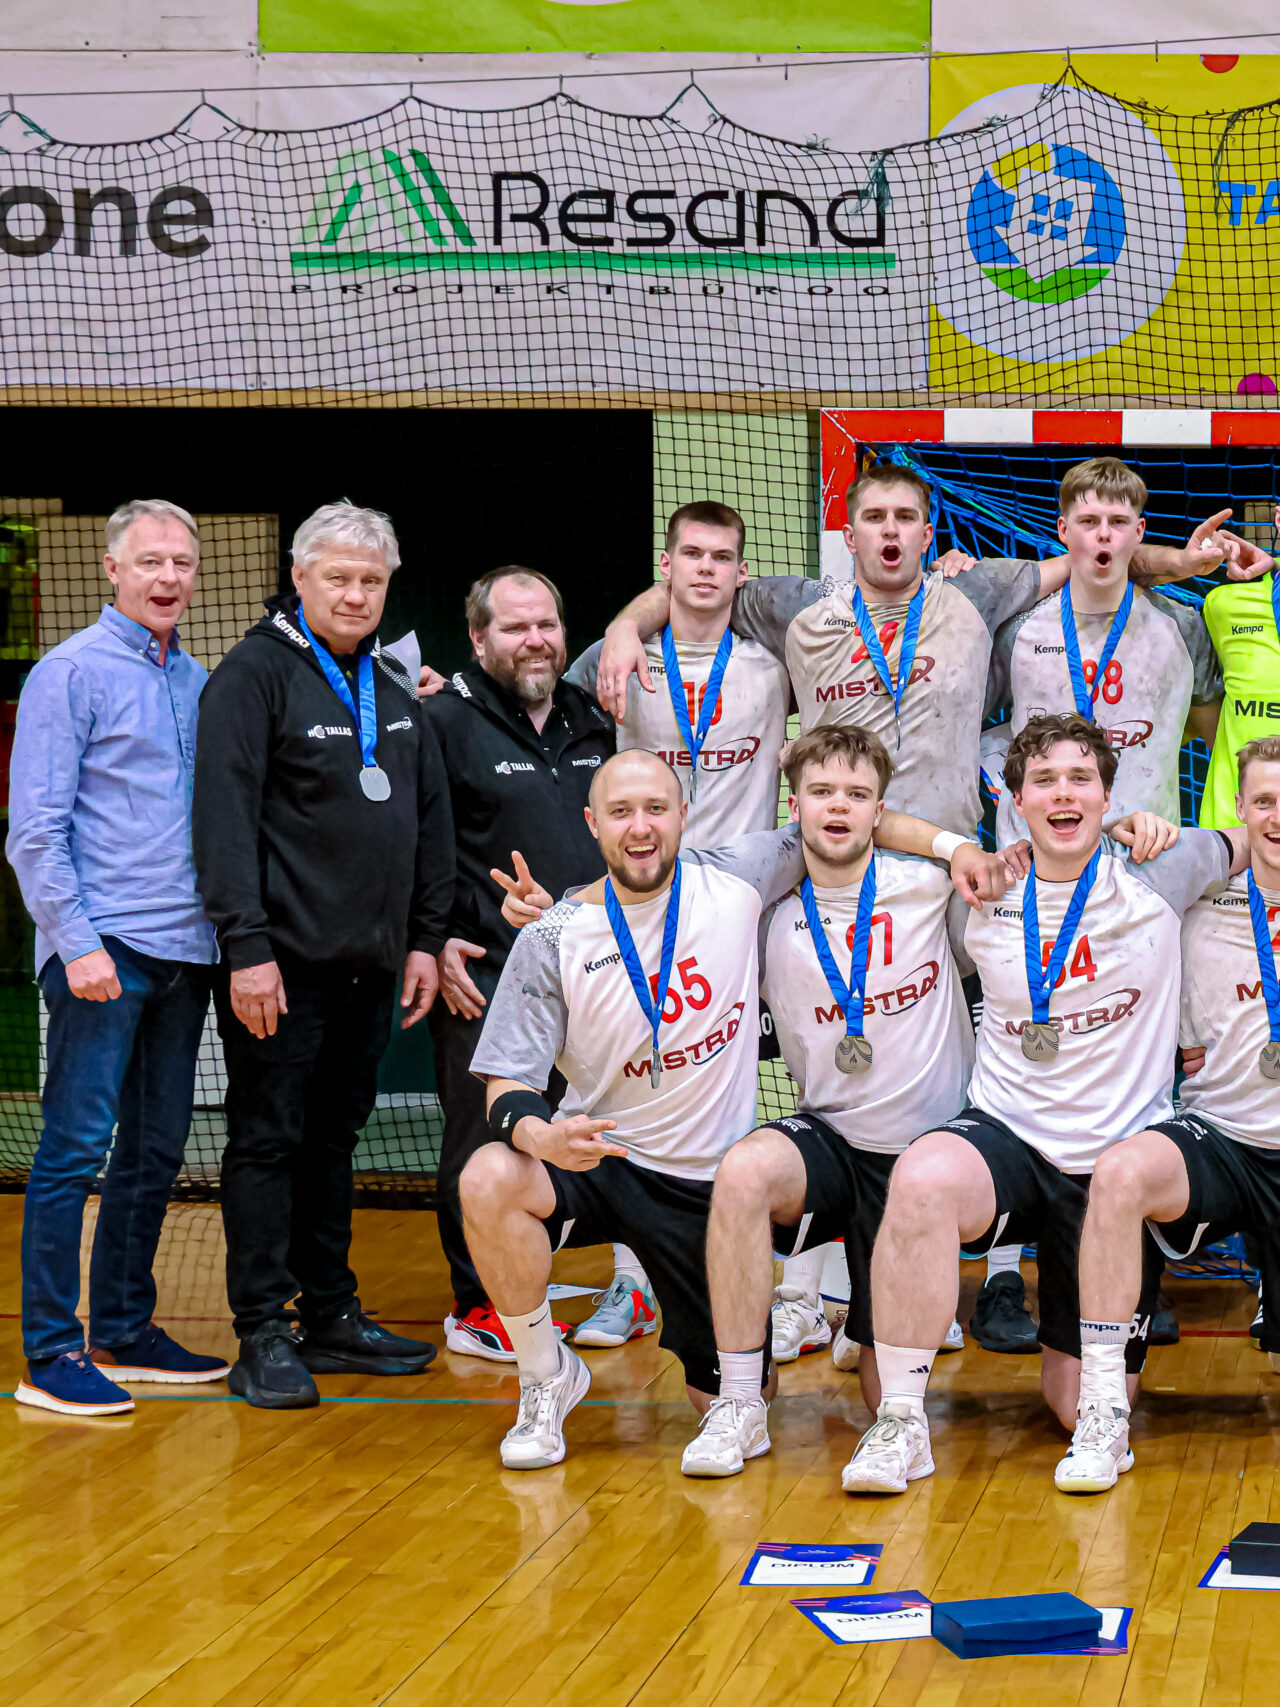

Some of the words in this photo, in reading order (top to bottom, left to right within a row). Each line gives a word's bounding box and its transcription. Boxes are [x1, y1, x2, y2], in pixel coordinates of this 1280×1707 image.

[0, 185, 214, 257] one
[274, 611, 310, 648] Kempa
[1231, 624, 1264, 635] Kempa
[1034, 644, 1067, 656] Kemp
[815, 667, 932, 703] MISTA
[326, 726, 352, 737] TALLAS
[1212, 897, 1250, 908] Kemp
[993, 907, 1024, 921] Kem
[794, 916, 832, 931] Kea
[584, 952, 622, 974] Kemp
[814, 975, 938, 1025] MSTRA
[1004, 1001, 1136, 1038] MSTRA
[622, 1014, 743, 1079] MSTRA
[1128, 1313, 1151, 1341] 54
[771, 1562, 856, 1570] DIPLOM
[837, 1611, 924, 1623] DIPLOM
